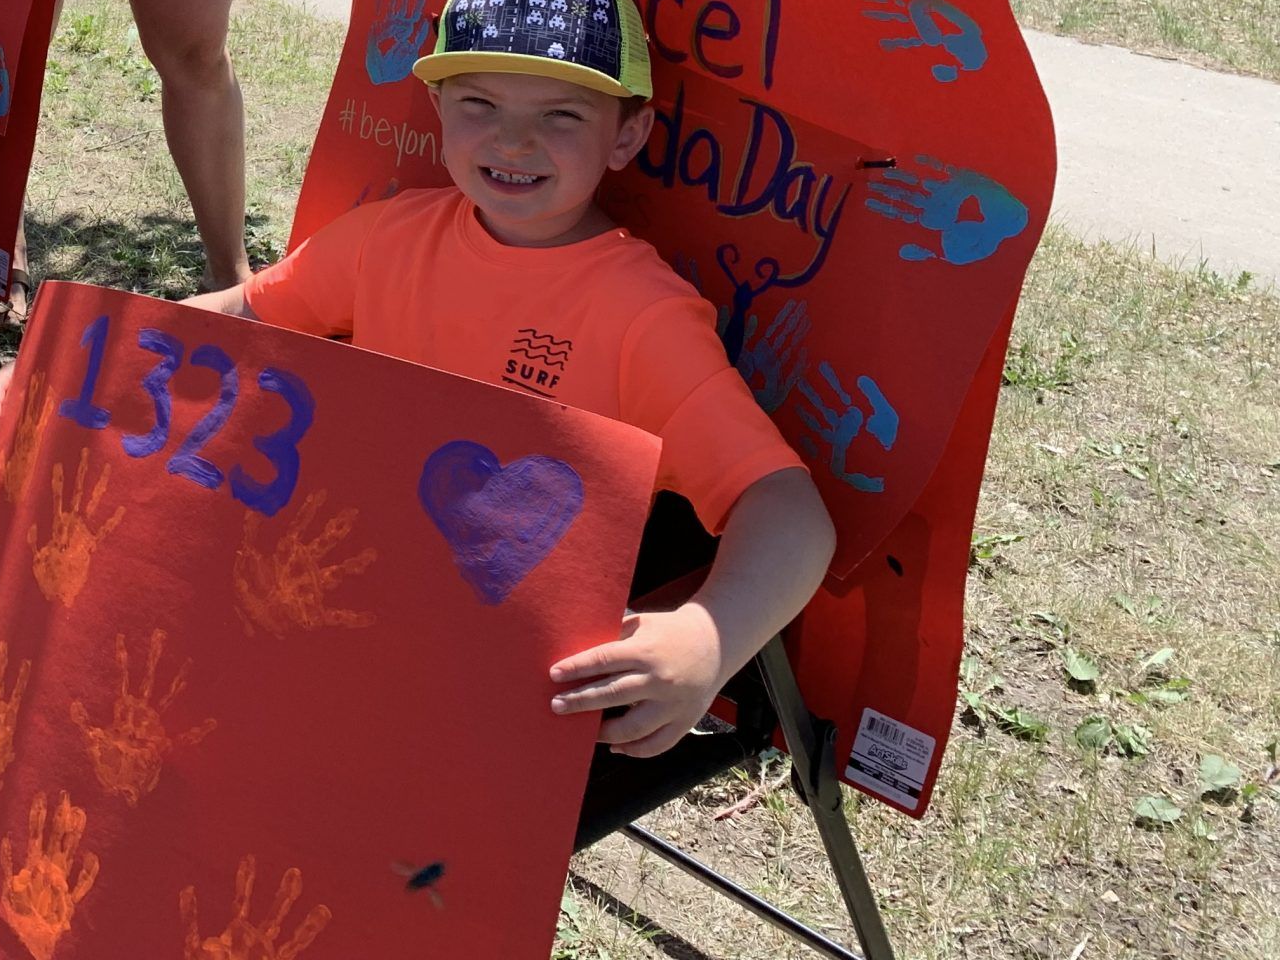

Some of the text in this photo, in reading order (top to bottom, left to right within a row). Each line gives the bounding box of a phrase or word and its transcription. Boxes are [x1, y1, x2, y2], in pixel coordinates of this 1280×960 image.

[338, 97, 448, 168] #beyon
[505, 359, 560, 389] SURF
[59, 315, 317, 518] 1323
